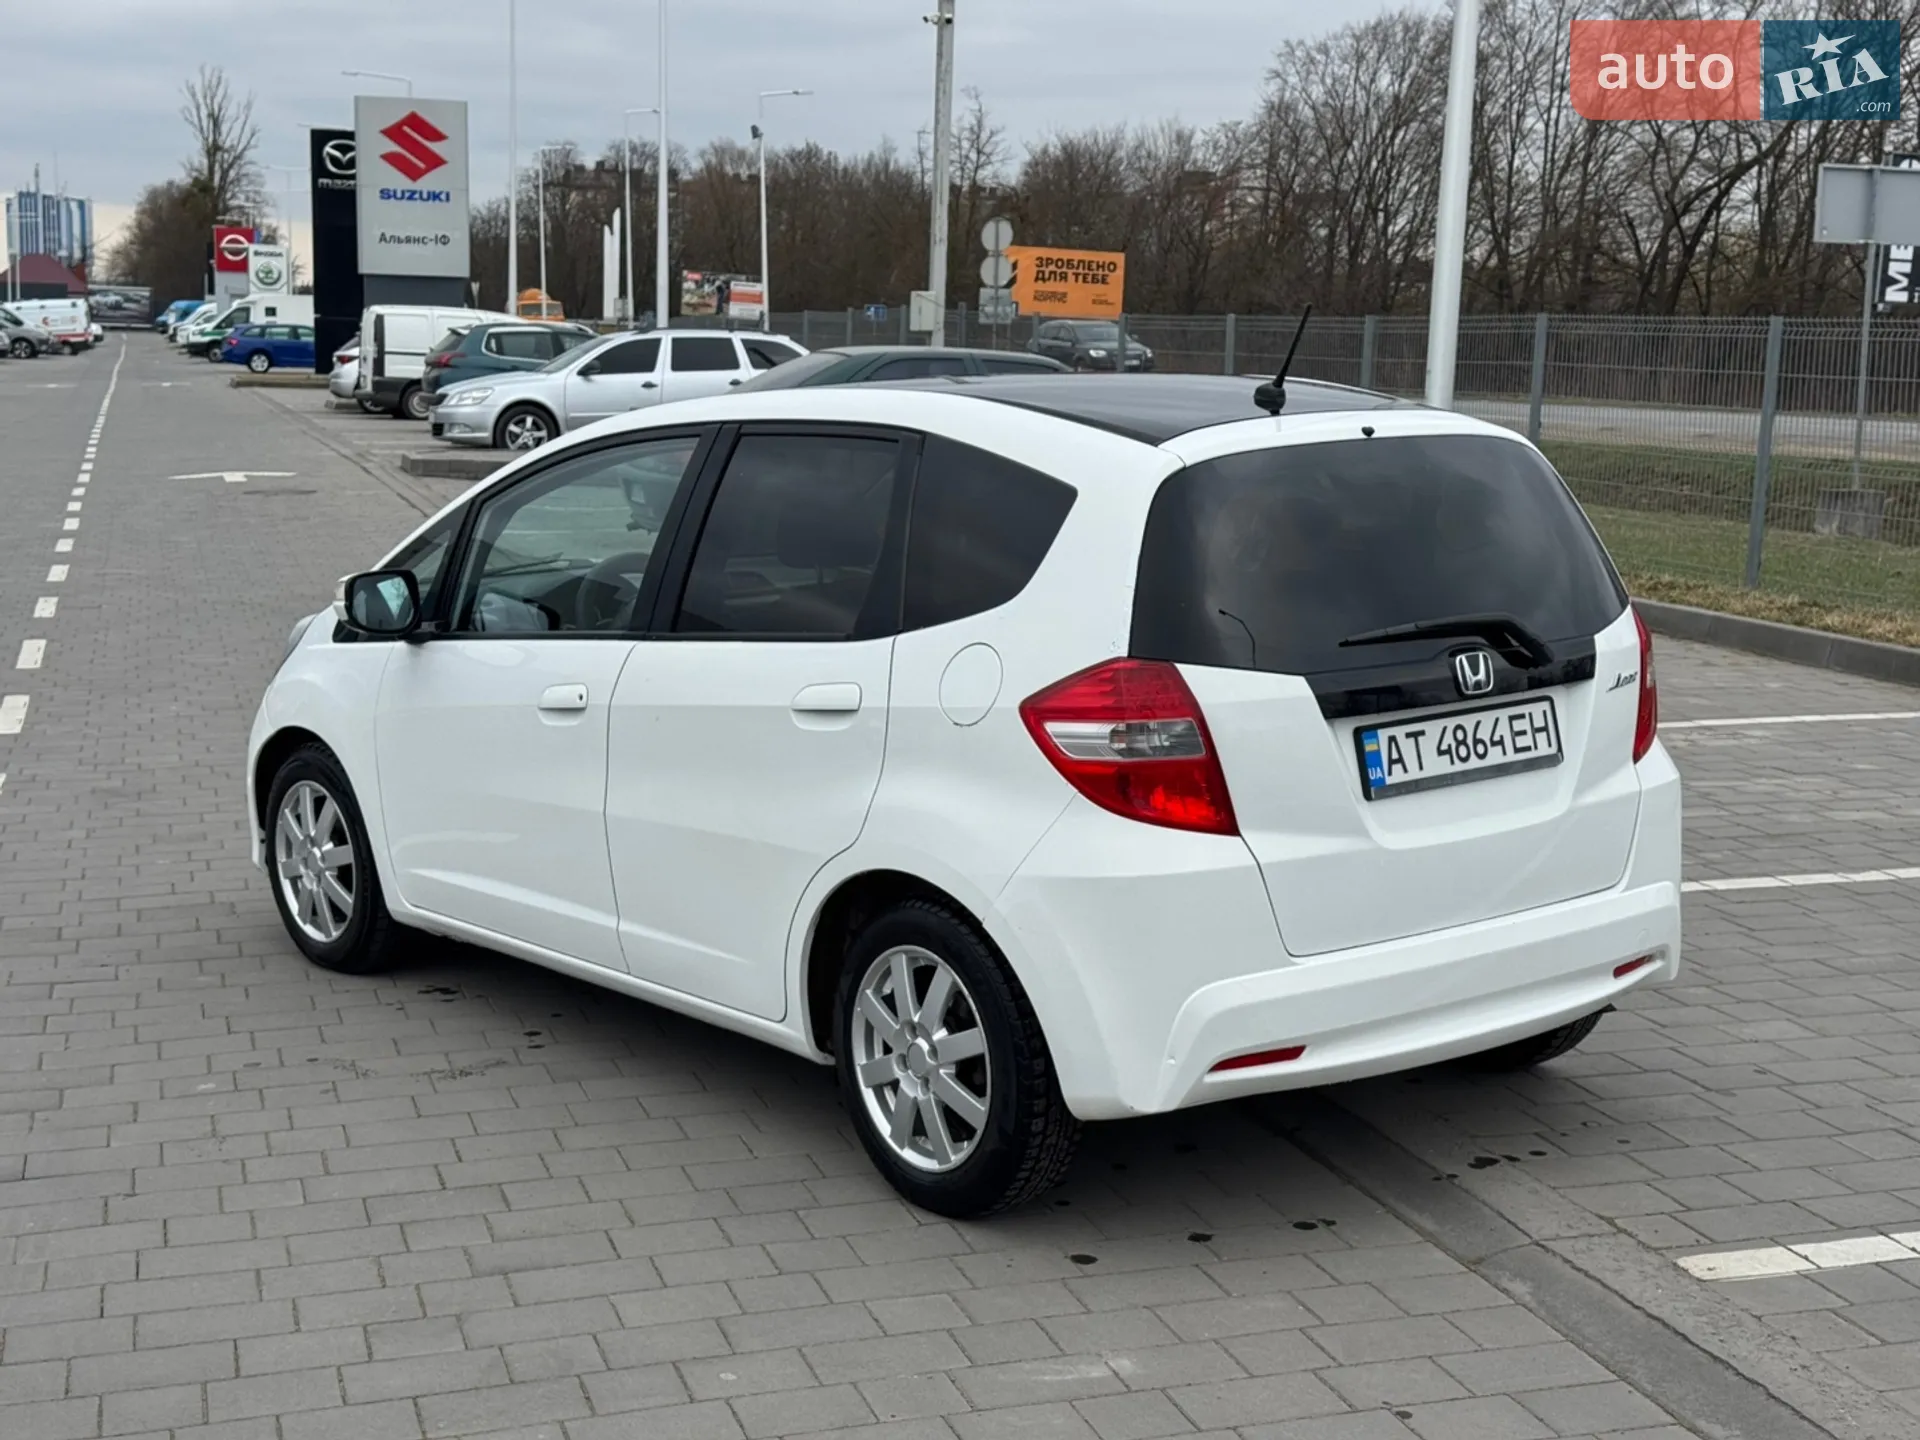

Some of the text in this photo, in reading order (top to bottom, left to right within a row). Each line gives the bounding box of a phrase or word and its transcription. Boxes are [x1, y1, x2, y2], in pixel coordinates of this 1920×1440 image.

[379, 187, 451, 203] SUZUKI
[1035, 256, 1117, 273] ЗРОБЛЕНО
[1034, 270, 1110, 285] ДЛЯ ТЕБЕ
[1387, 709, 1552, 777] AT 4864 EH
[1368, 767, 1384, 780] UA
